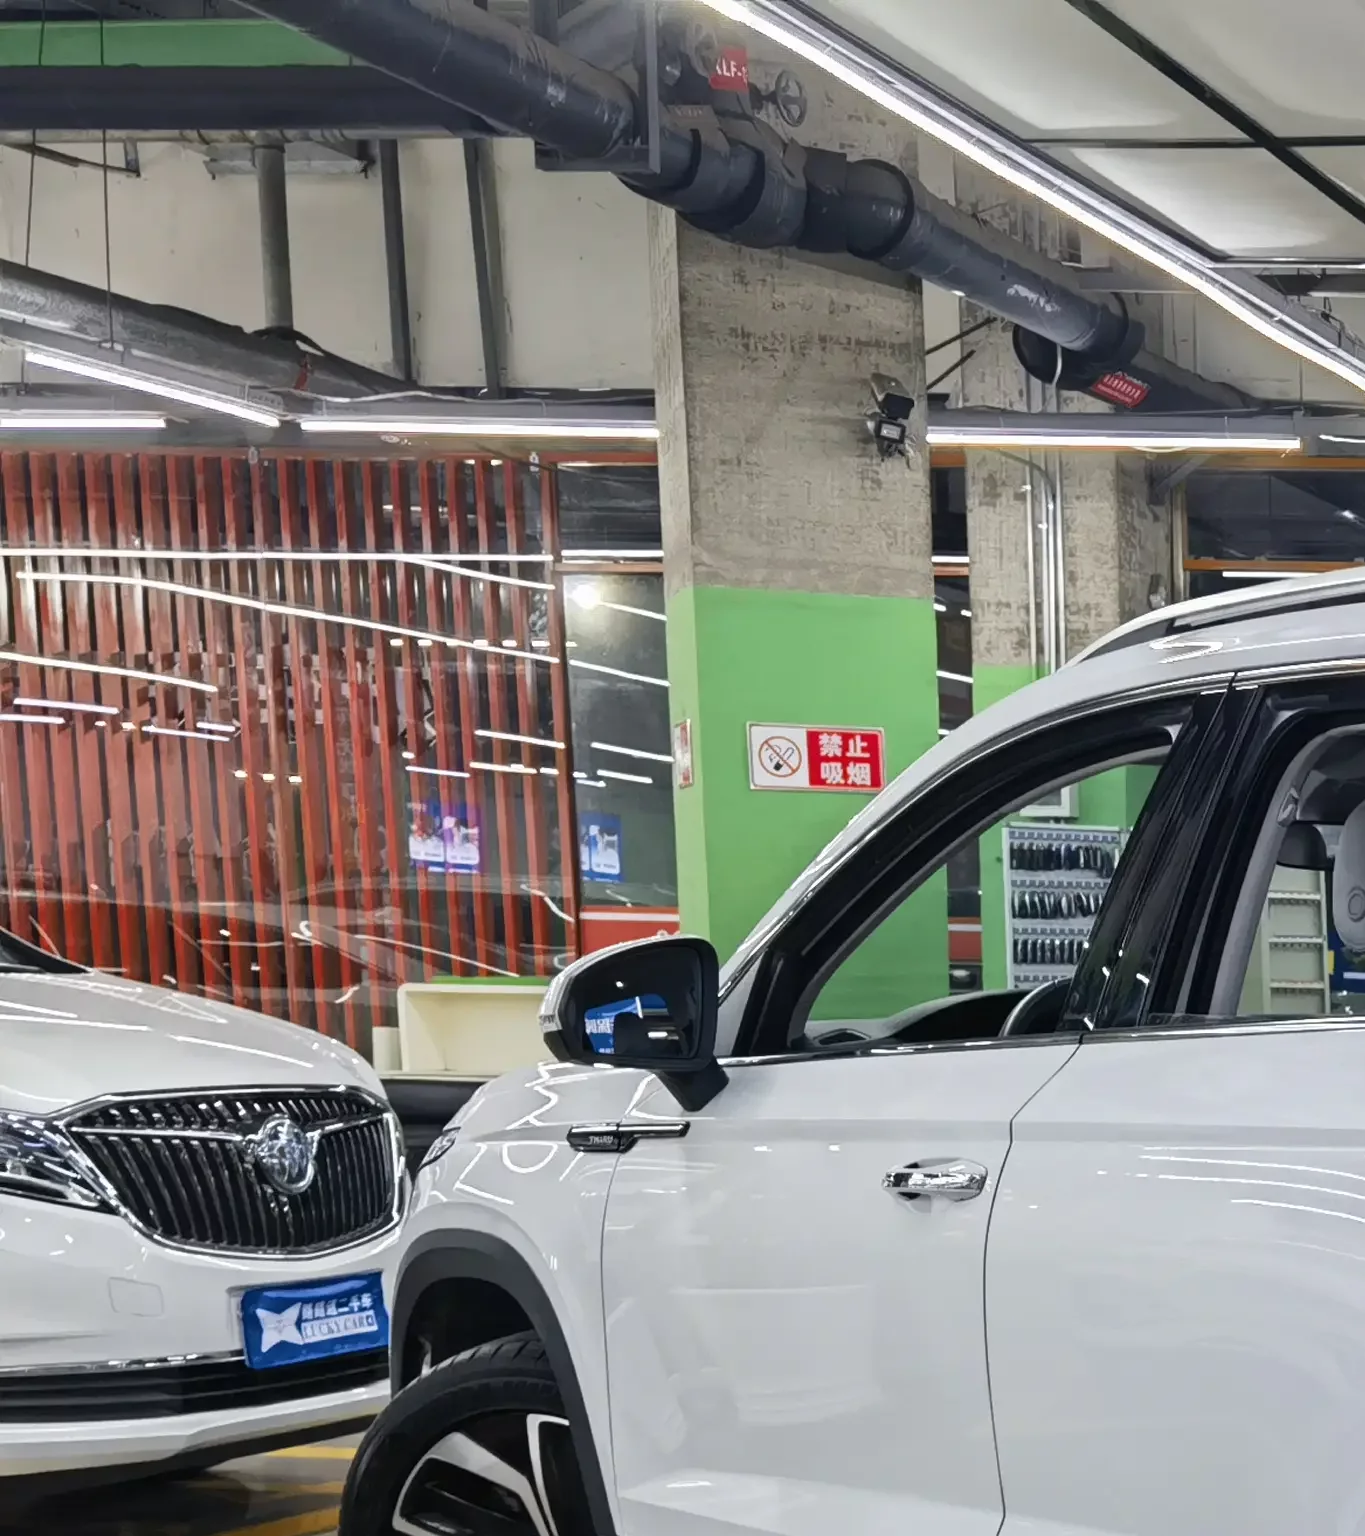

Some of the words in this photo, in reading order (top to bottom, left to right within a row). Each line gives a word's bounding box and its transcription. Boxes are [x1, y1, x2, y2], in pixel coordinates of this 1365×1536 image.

[819, 733, 871, 758] 禁止
[820, 761, 872, 786] 吸烟
[343, 1315, 365, 1332] CAR
